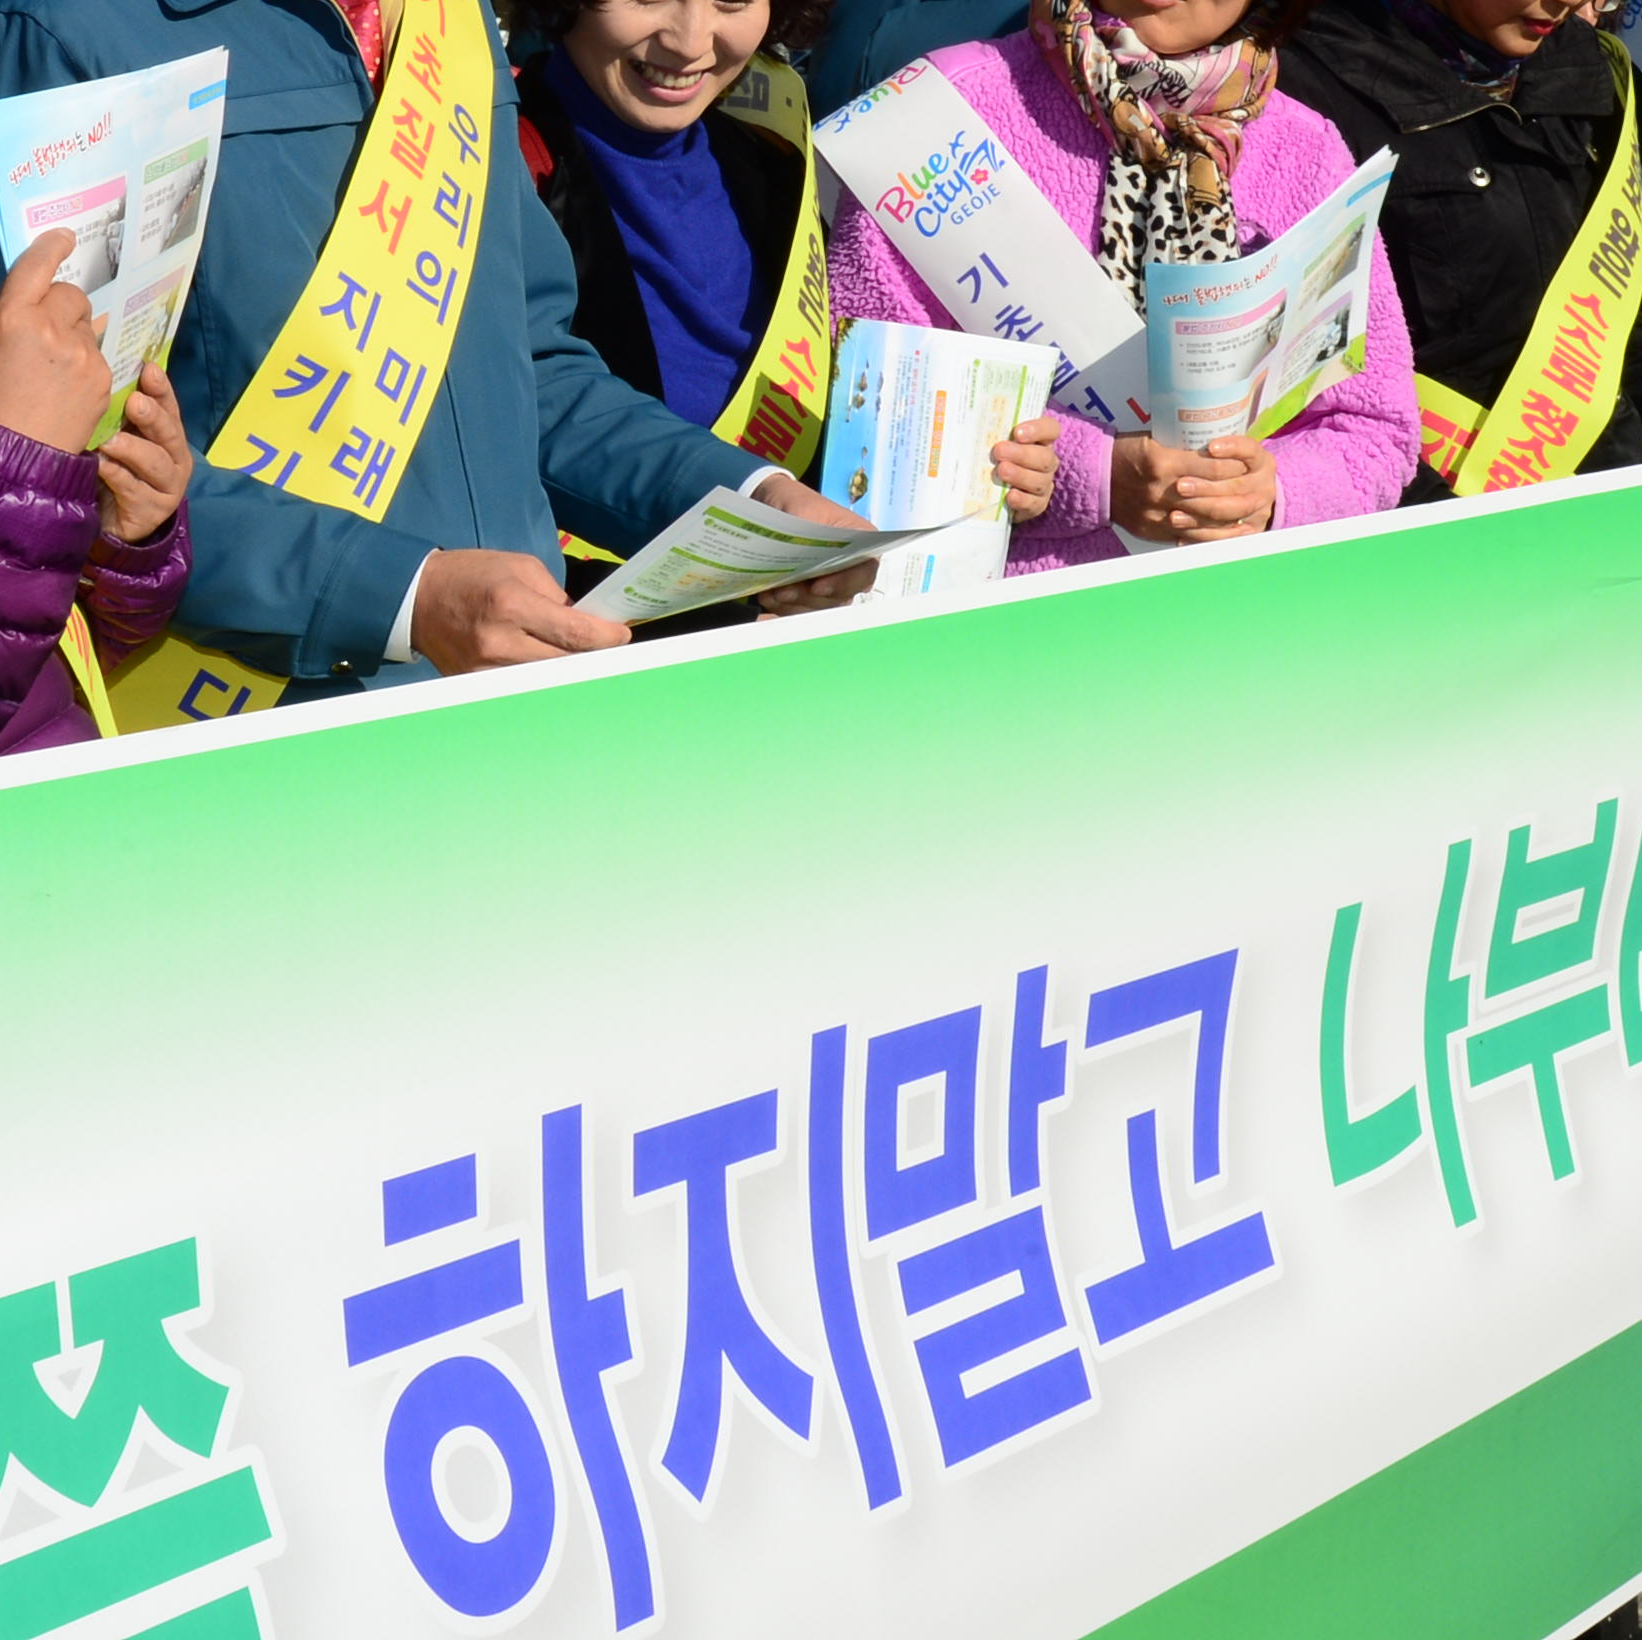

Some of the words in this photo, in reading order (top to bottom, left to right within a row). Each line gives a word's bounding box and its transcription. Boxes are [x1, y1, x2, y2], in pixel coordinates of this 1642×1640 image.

[407, 102, 484, 326] 우리의
[876, 150, 951, 225] Blue
[914, 167, 970, 238] City
[950, 183, 1002, 226] GEOJE
[330, 348, 428, 509] 미래
[342, 948, 1279, 1635] 하지말고
